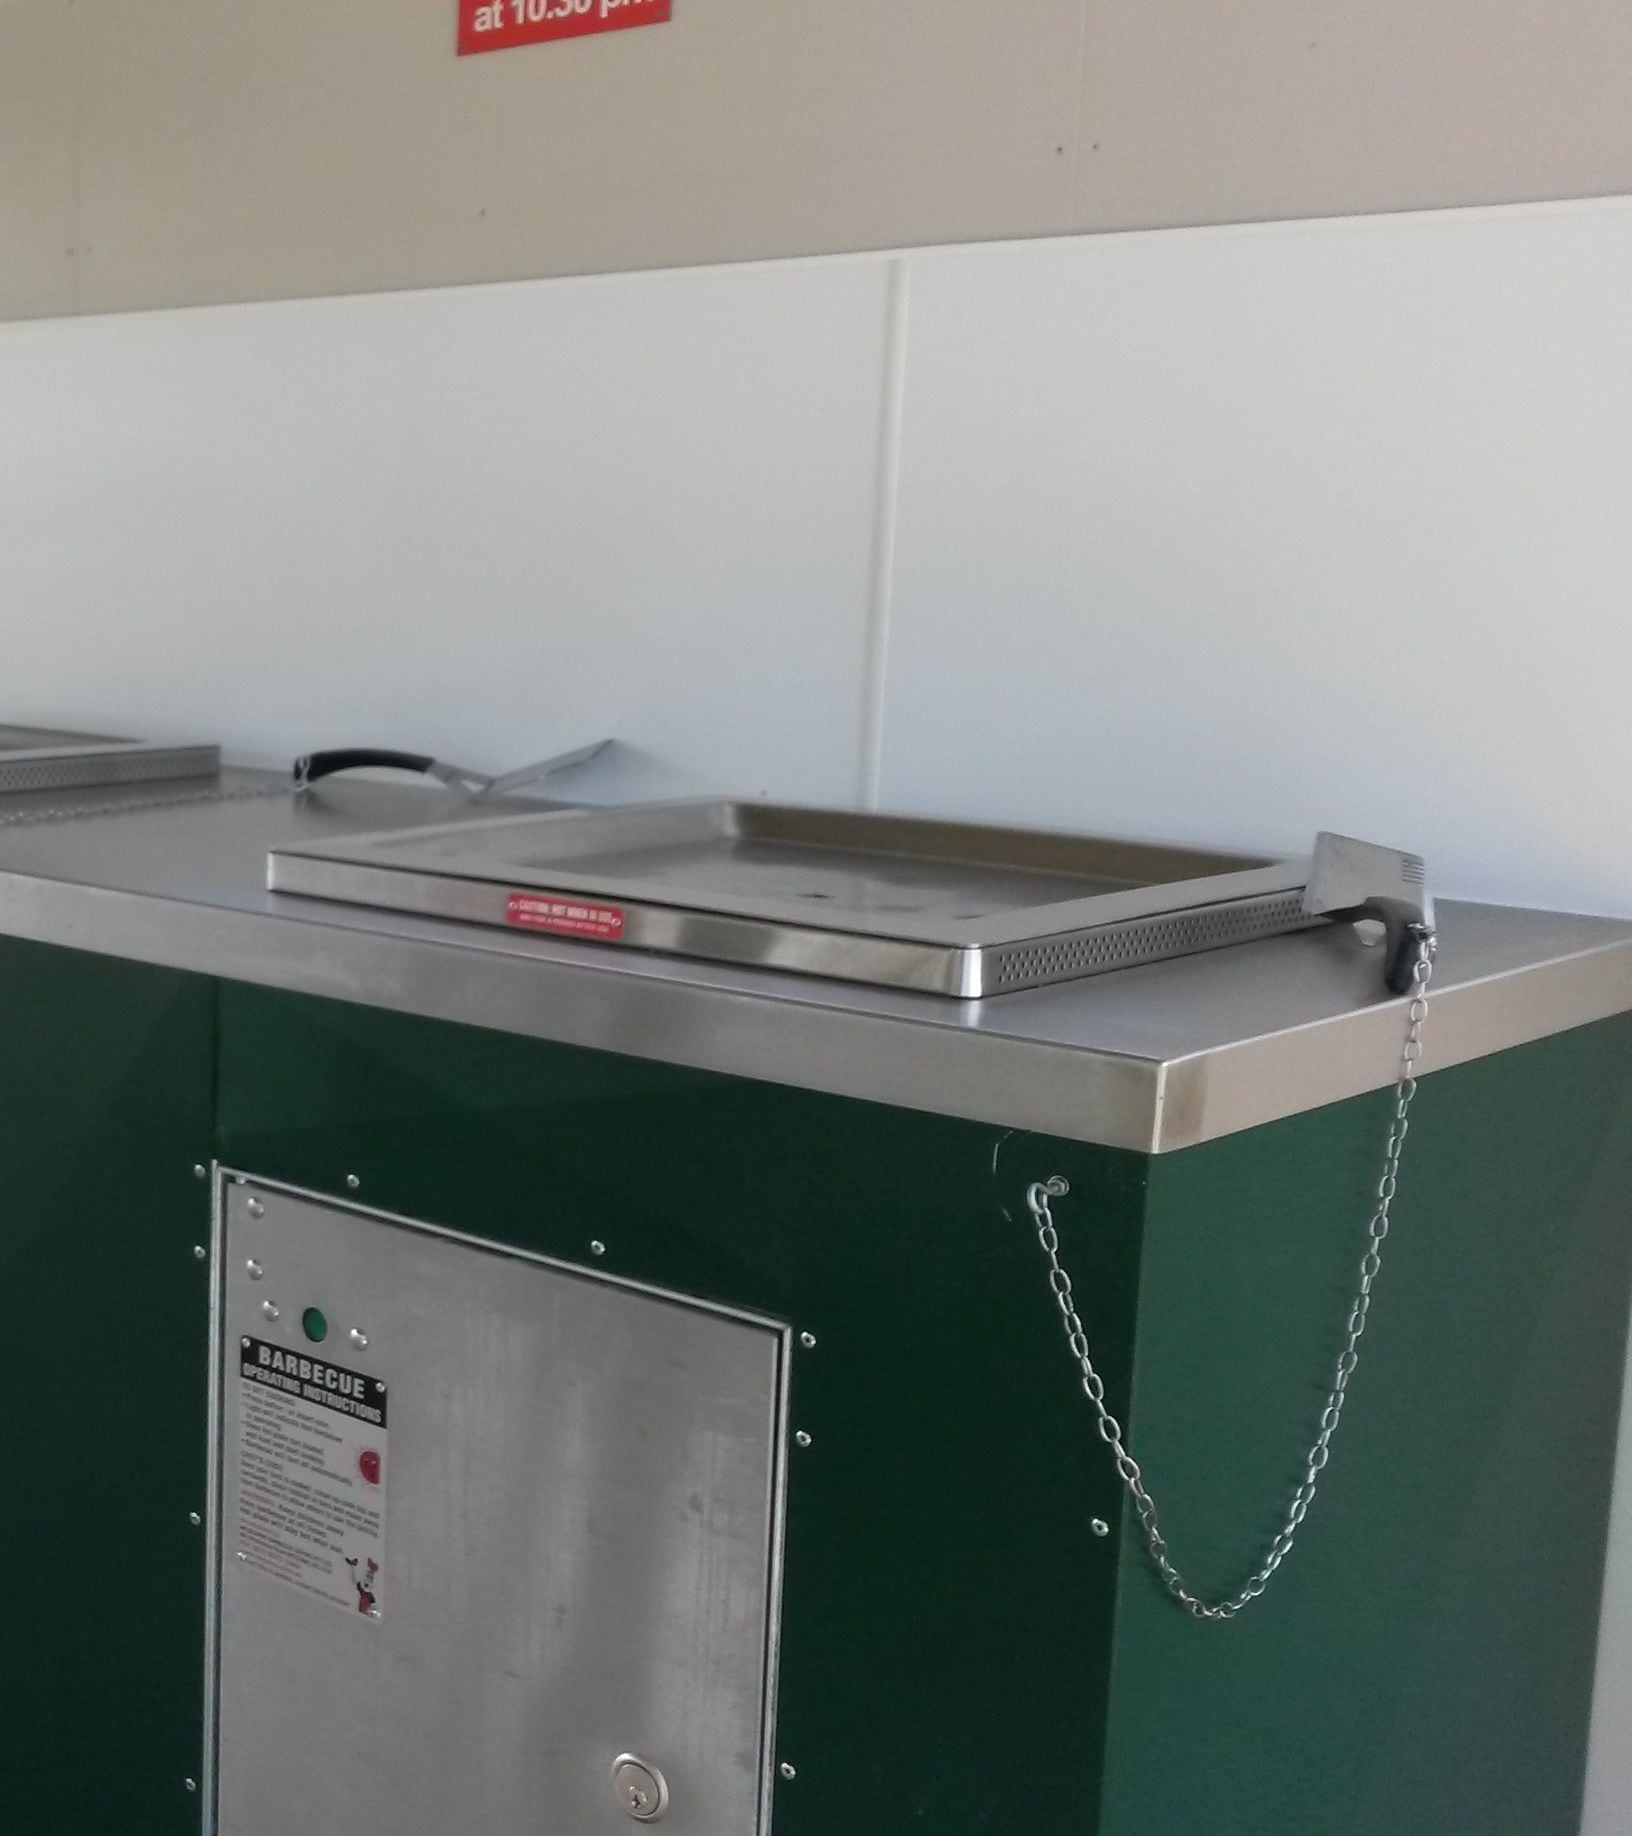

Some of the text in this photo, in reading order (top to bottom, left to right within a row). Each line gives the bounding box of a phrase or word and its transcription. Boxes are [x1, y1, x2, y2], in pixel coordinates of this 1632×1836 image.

[474, 0, 504, 31] at
[242, 1362, 382, 1424] OPERATING INSTRUCTIONS
[258, 1345, 366, 1400] BARBECUE
